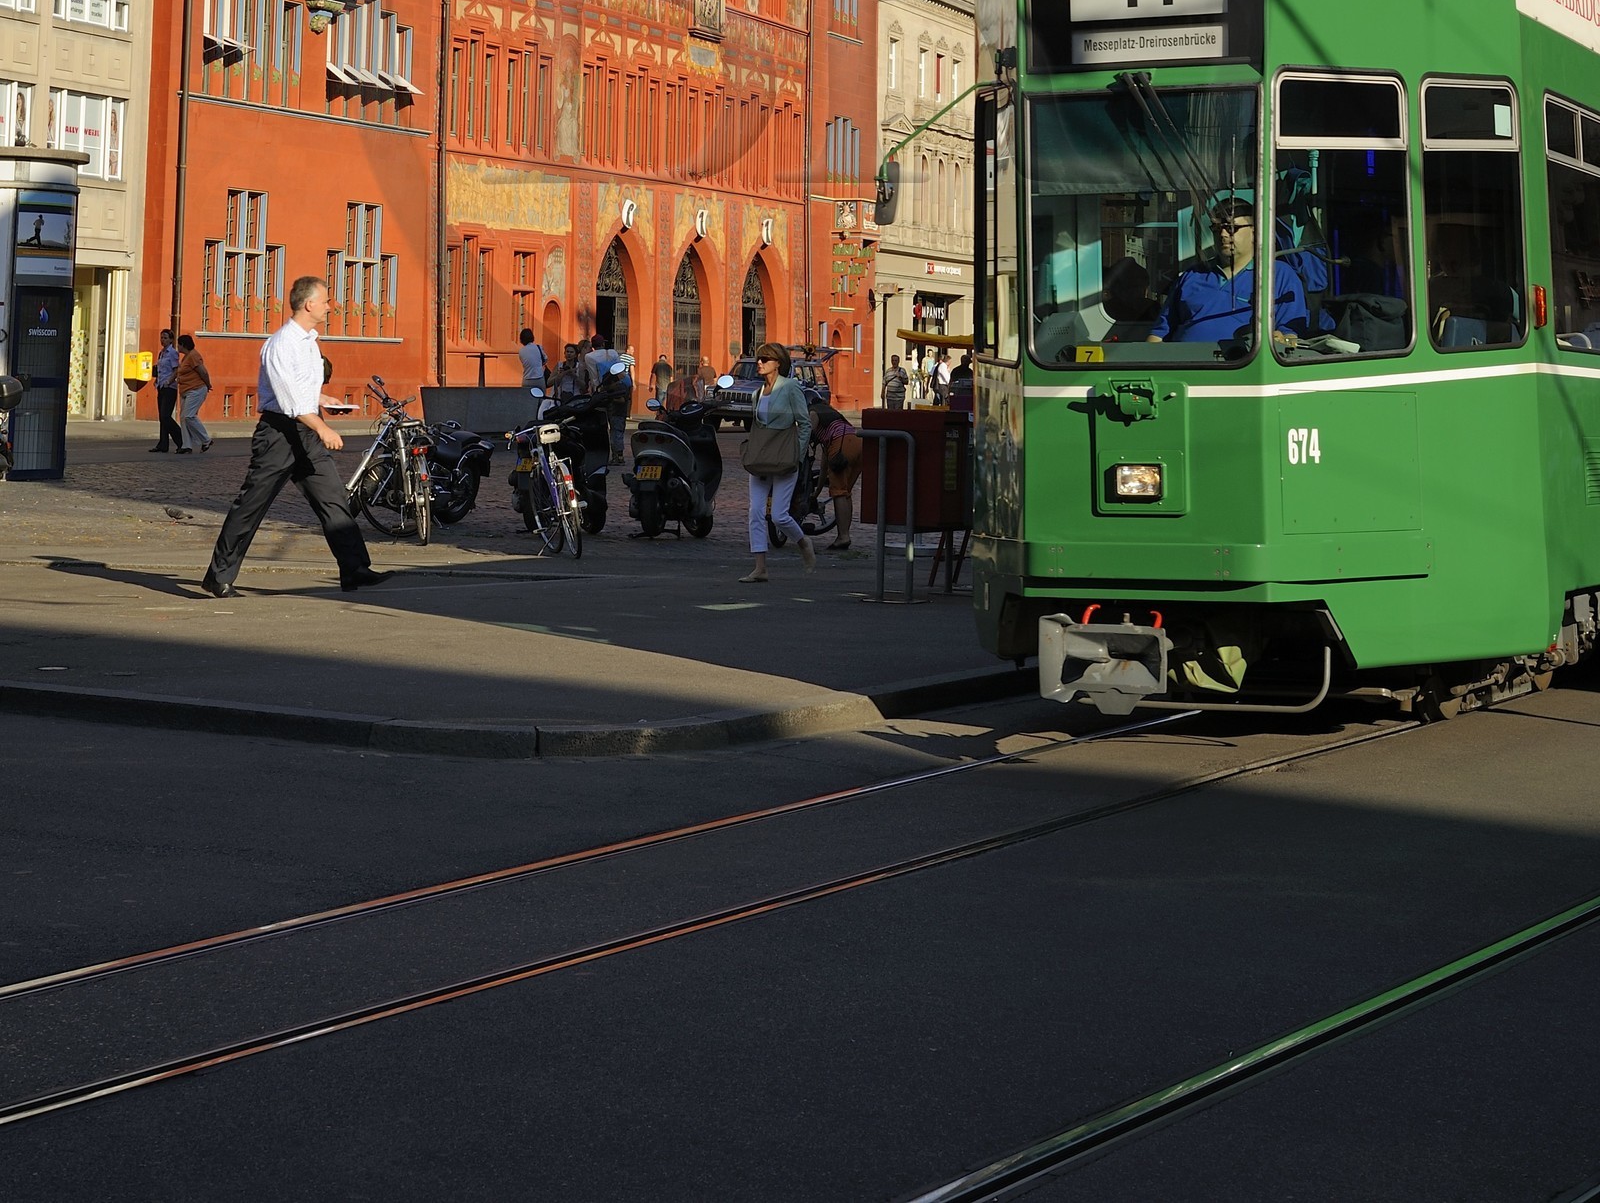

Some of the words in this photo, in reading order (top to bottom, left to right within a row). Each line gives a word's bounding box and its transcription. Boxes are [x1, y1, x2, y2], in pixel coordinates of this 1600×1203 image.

[1083, 33, 1216, 52] Messeplatz-Dreirosenbrücke
[65, 126, 79, 134] ALLY
[28, 327, 57, 337] swisscom
[1084, 351, 1093, 362] 7
[1287, 428, 1321, 464] 674
